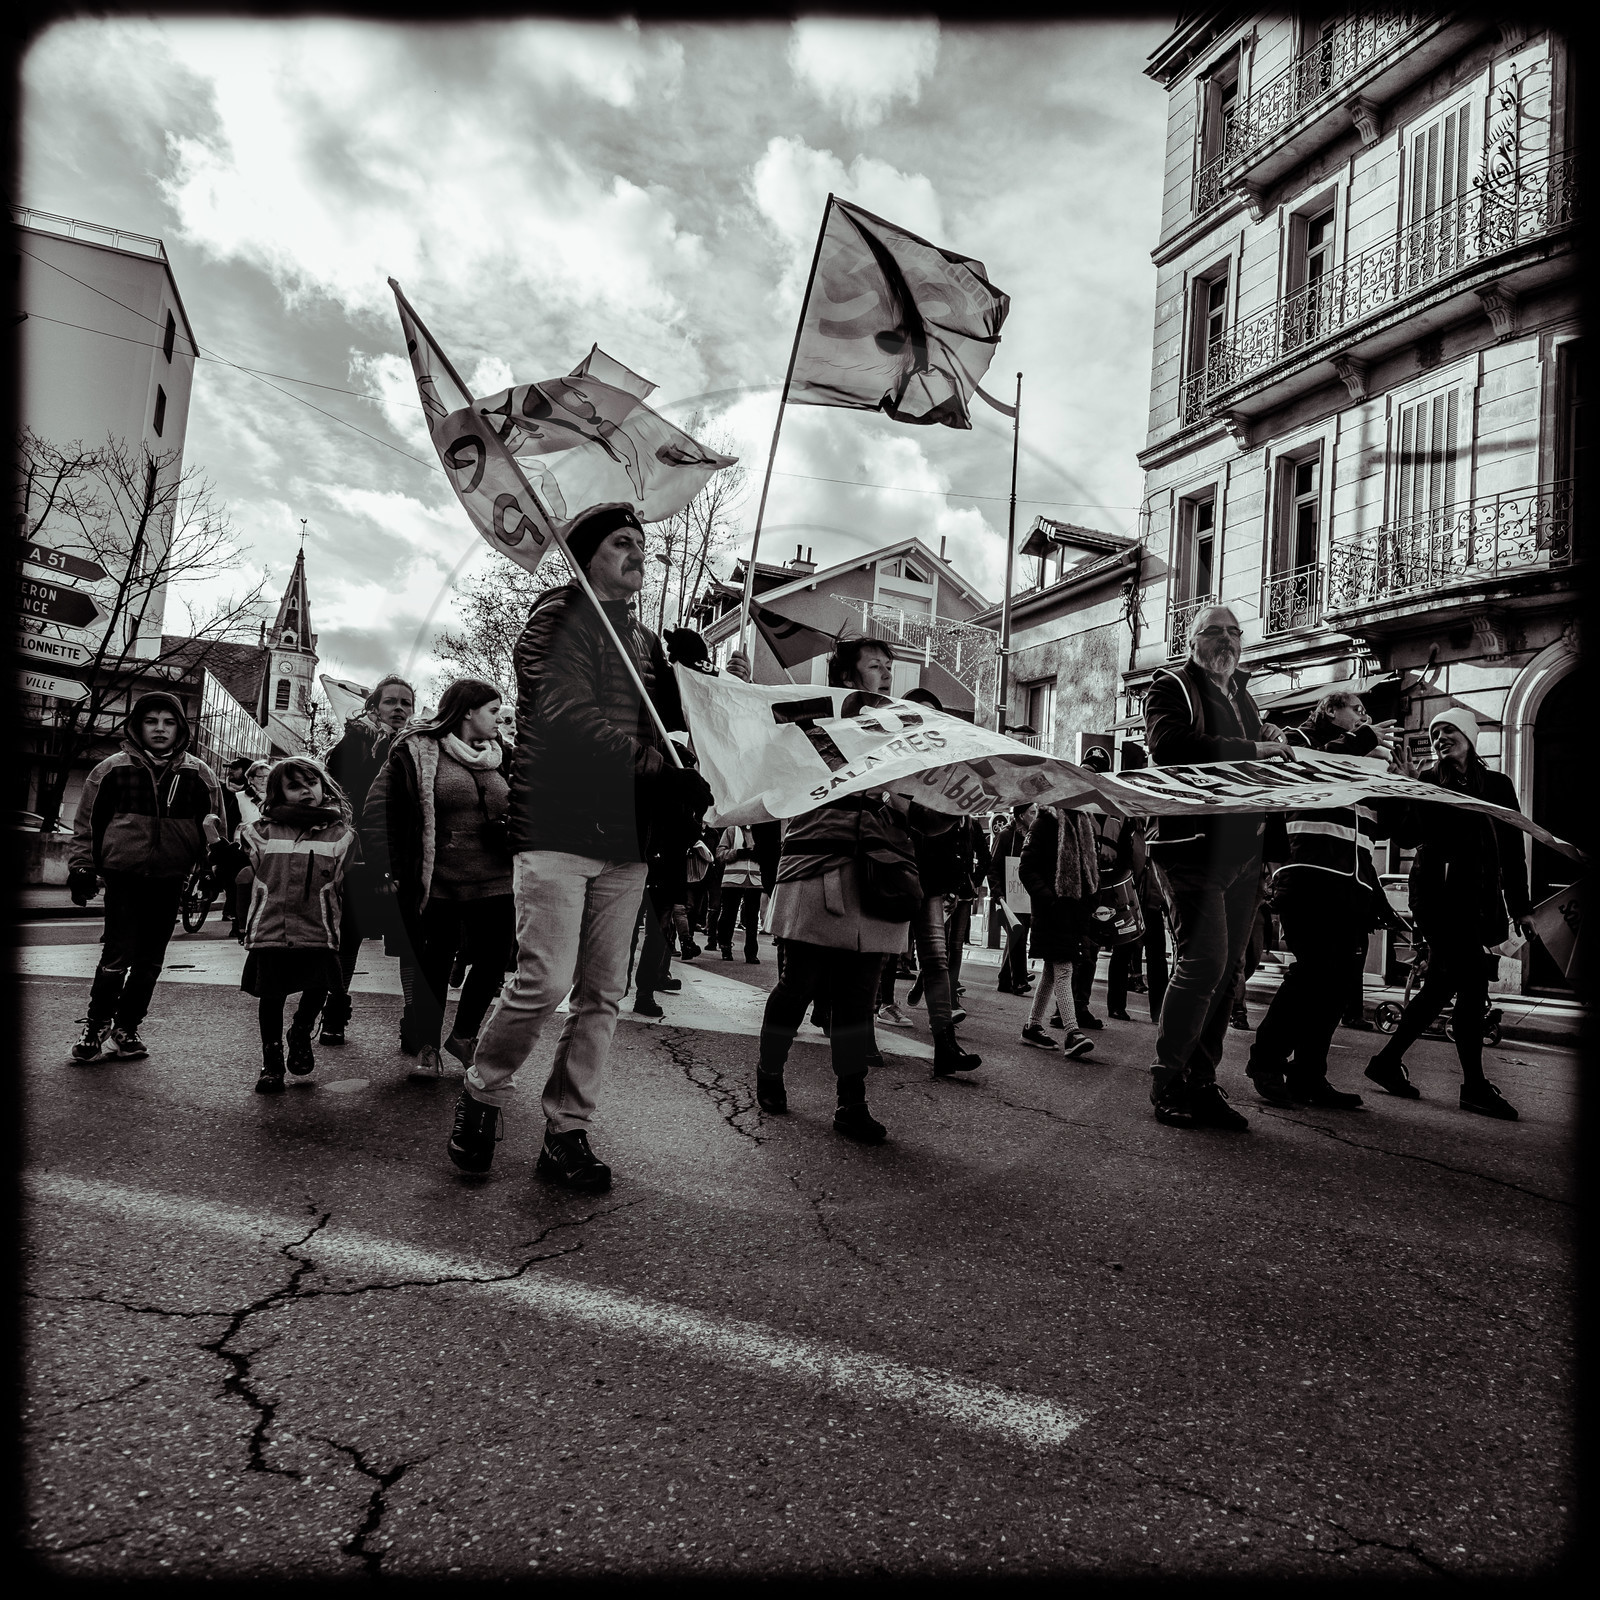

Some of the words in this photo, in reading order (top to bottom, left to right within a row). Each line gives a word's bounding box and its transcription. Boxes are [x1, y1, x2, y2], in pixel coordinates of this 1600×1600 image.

[29, 547, 41, 561] A
[47, 553, 67, 568] 51
[26, 676, 56, 691] VILLE
